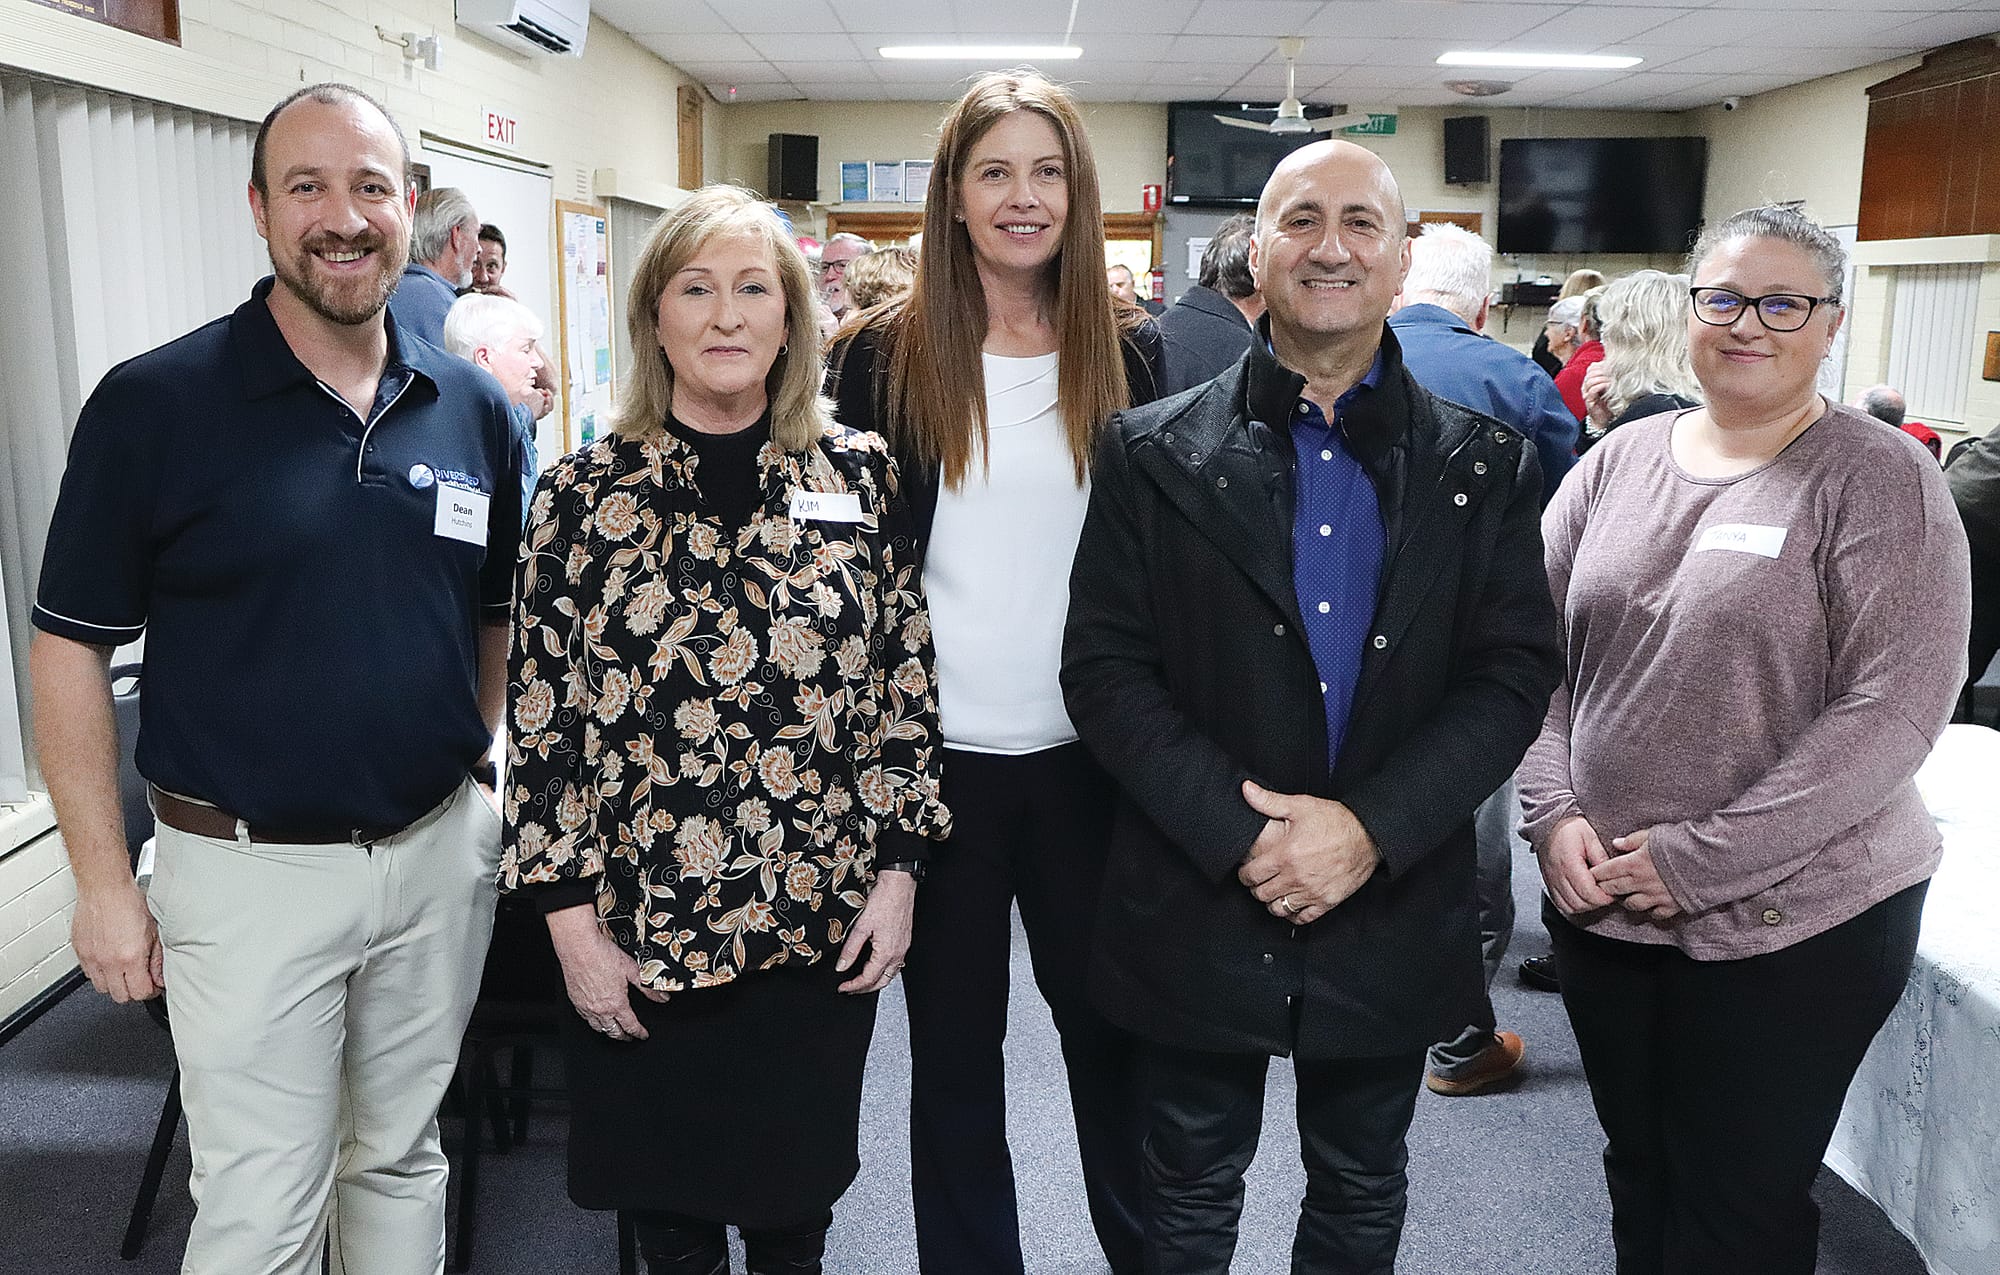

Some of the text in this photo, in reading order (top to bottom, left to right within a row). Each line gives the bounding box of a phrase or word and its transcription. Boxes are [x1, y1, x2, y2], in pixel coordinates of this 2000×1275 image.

[488, 113, 516, 145] EXIT
[453, 503, 473, 516] Dean
[798, 499, 820, 513] KIM
